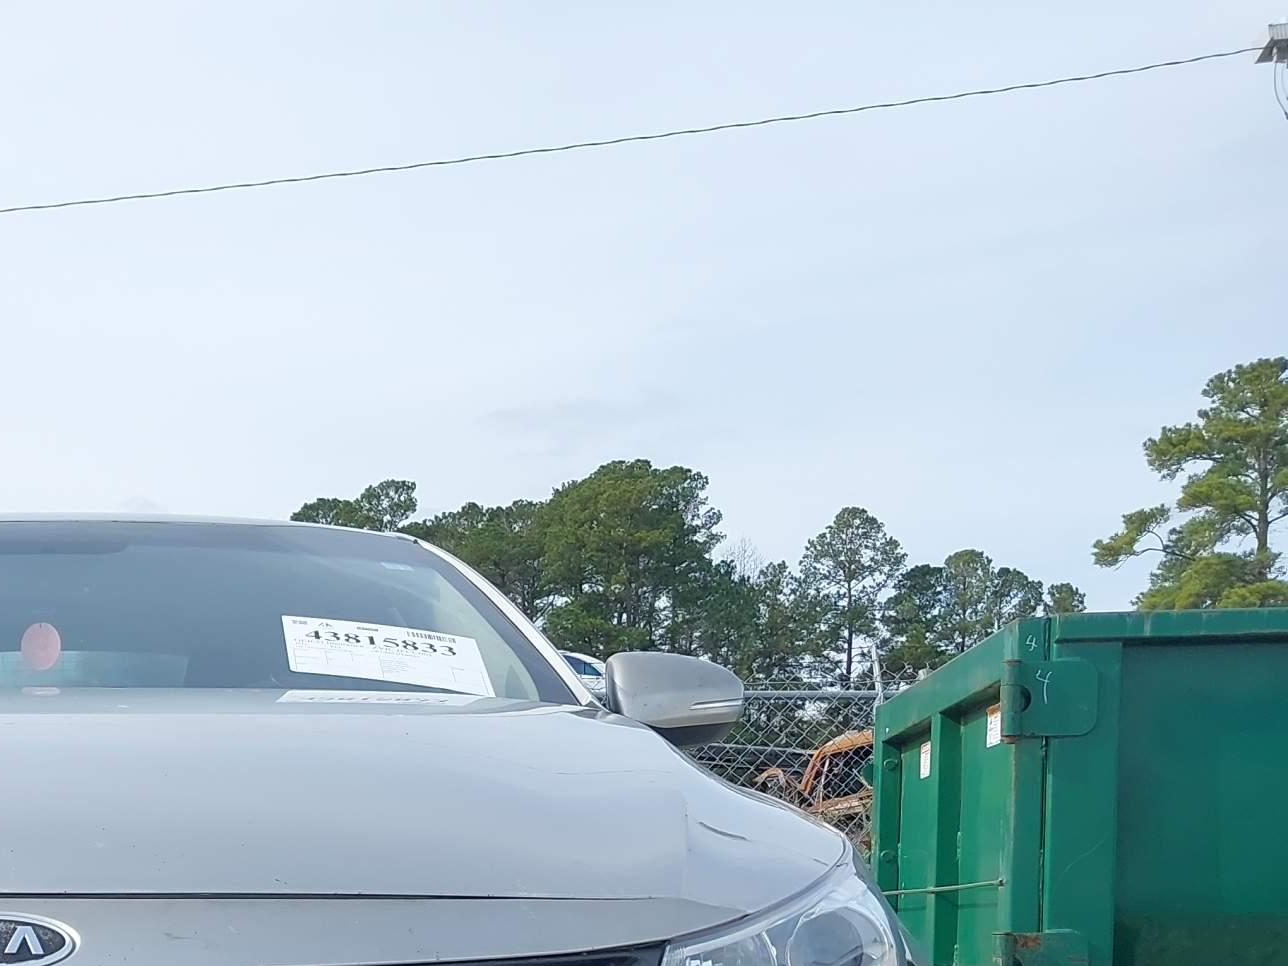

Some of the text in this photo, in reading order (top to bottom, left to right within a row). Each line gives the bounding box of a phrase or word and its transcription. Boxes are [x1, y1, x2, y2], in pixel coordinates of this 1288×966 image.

[305, 630, 457, 656] 43815833
[1026, 634, 1038, 652] 4
[1035, 669, 1053, 705] 4
